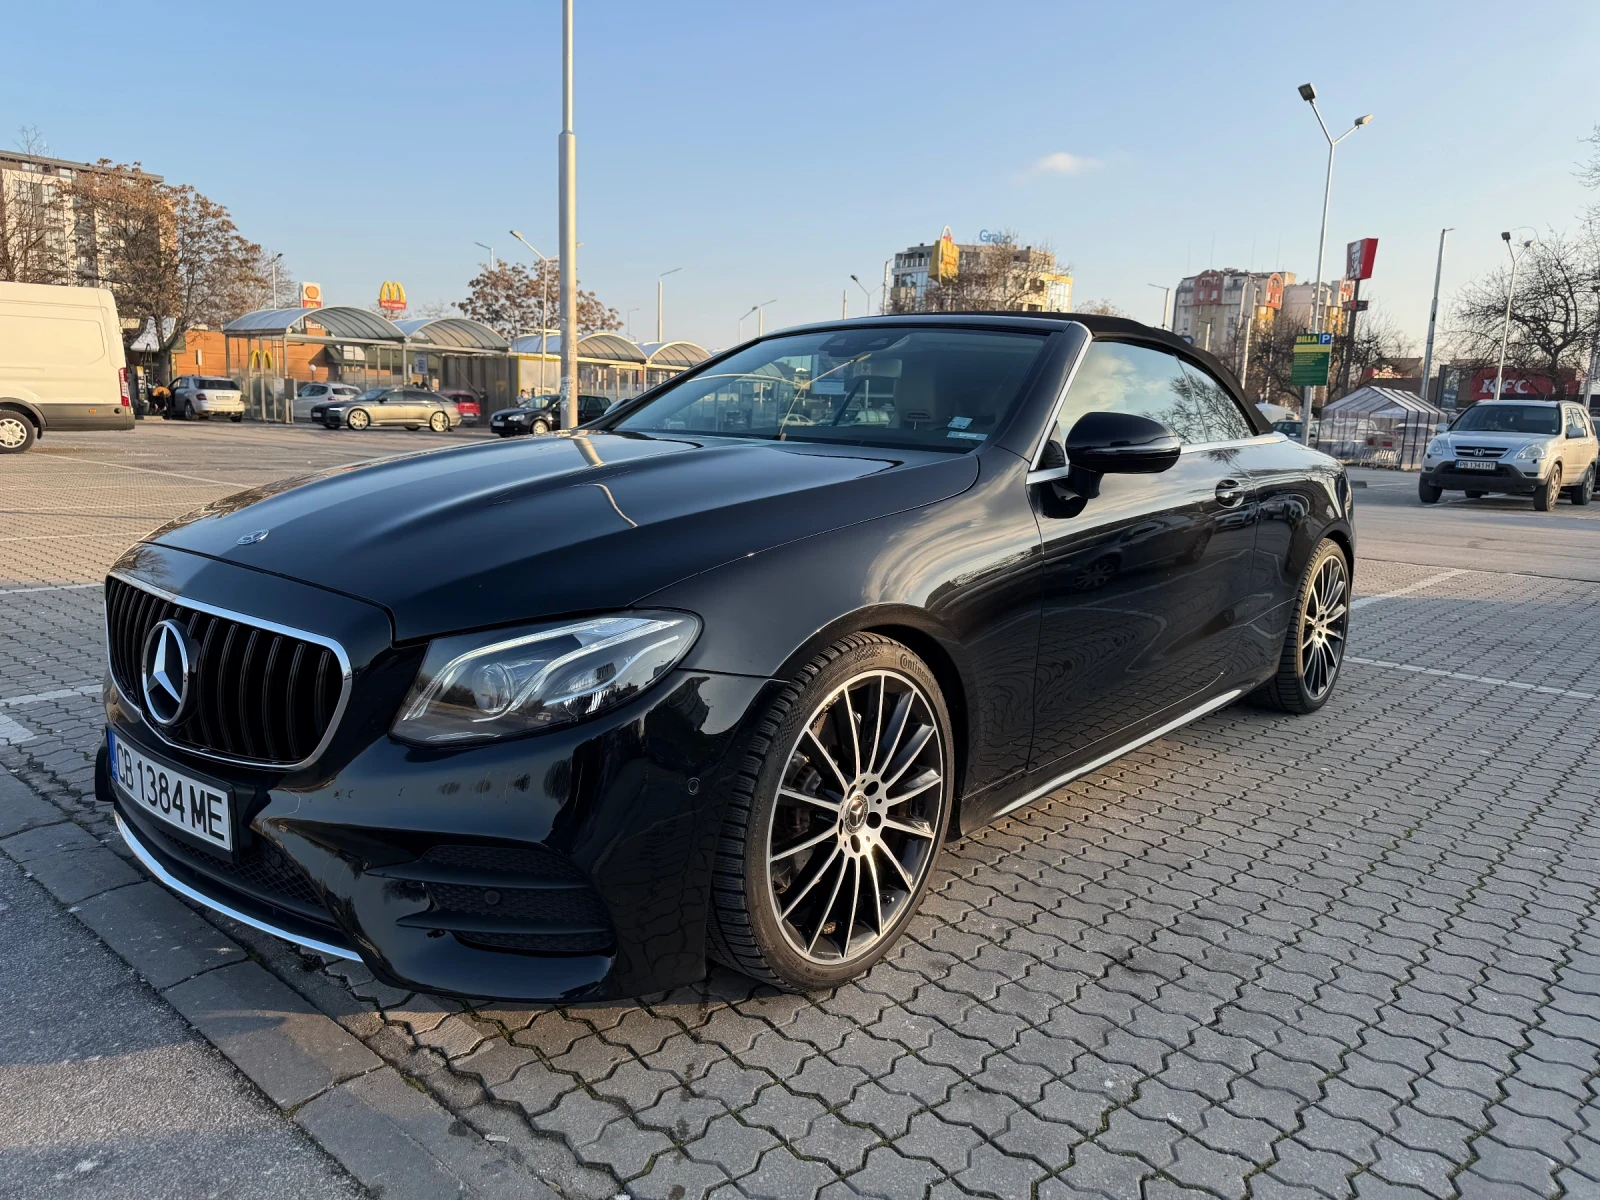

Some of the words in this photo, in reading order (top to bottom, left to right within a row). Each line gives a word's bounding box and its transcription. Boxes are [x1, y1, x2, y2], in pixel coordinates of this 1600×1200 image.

[1296, 335, 1318, 343] BILLA
[1321, 334, 1331, 344] P
[1479, 379, 1530, 394] KFC
[900, 653, 940, 700] Continental
[116, 742, 134, 791] CB
[137, 759, 186, 823] 1384
[189, 785, 225, 842] ME
